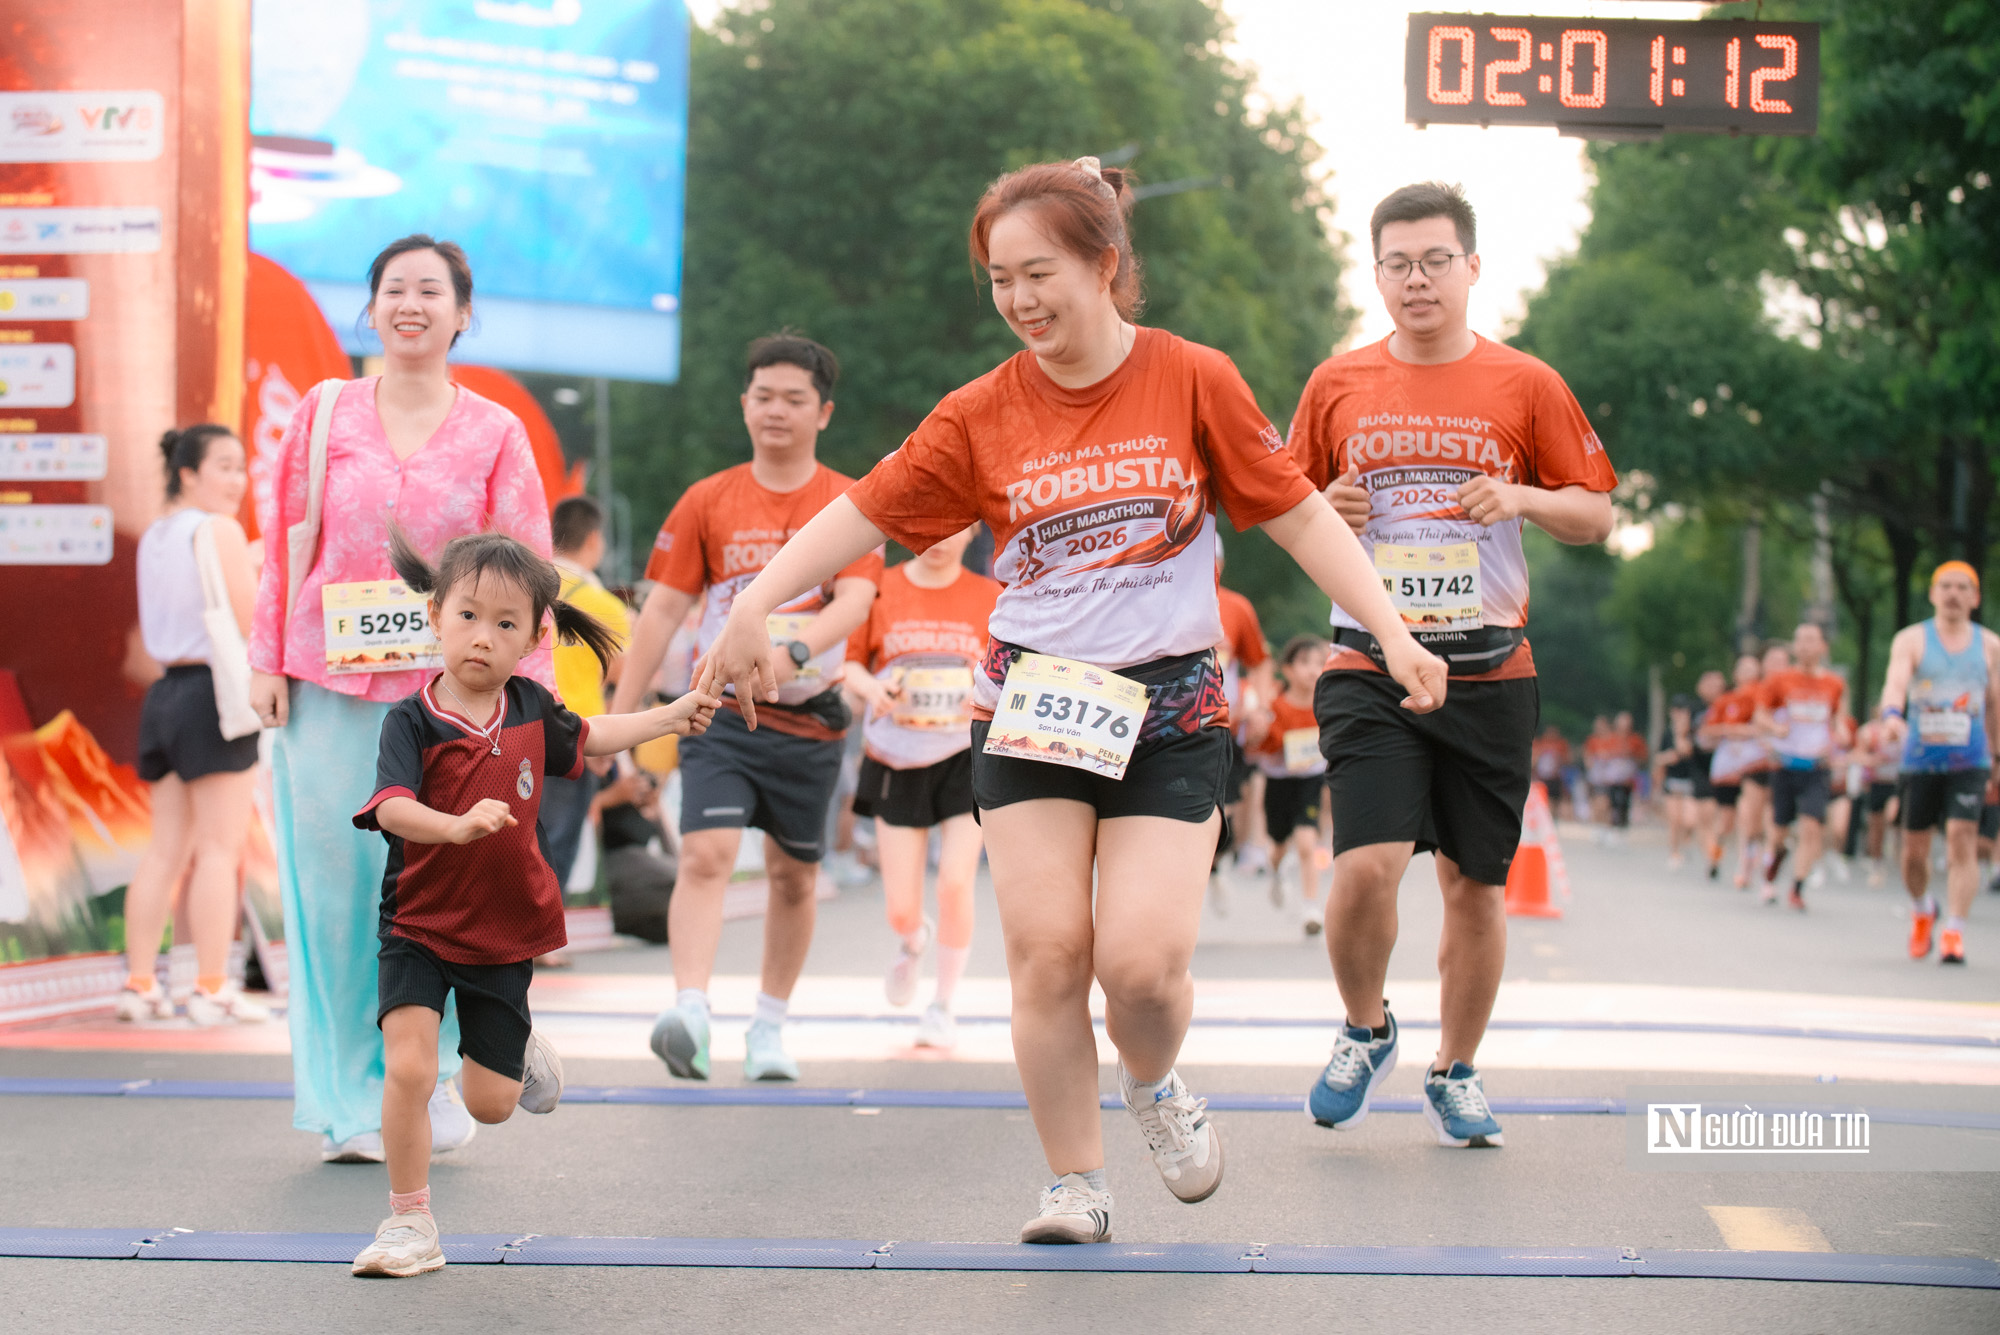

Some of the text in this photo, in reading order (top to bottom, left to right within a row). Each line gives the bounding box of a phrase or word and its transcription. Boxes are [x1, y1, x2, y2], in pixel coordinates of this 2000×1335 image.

[1358, 411, 1492, 433] BUÔN MA THUỘT
[1022, 434, 1168, 474] BUÔN MA THUỘT
[1346, 430, 1502, 468] ROBUSTA
[1006, 457, 1187, 524] ROBUSTA
[1373, 470, 1471, 489] HALF MARATHON
[1391, 488, 1447, 507] 2026
[1041, 502, 1154, 541] HALF MARATHON
[1065, 526, 1128, 557] 2026
[1401, 574, 1474, 597] 51742
[338, 619, 346, 633] F
[1420, 631, 1467, 643] GARMIN
[1052, 664, 1071, 674] VTV8
[1010, 693, 1027, 711] M
[1033, 692, 1129, 739] 53176
[1098, 747, 1114, 760] PEN
